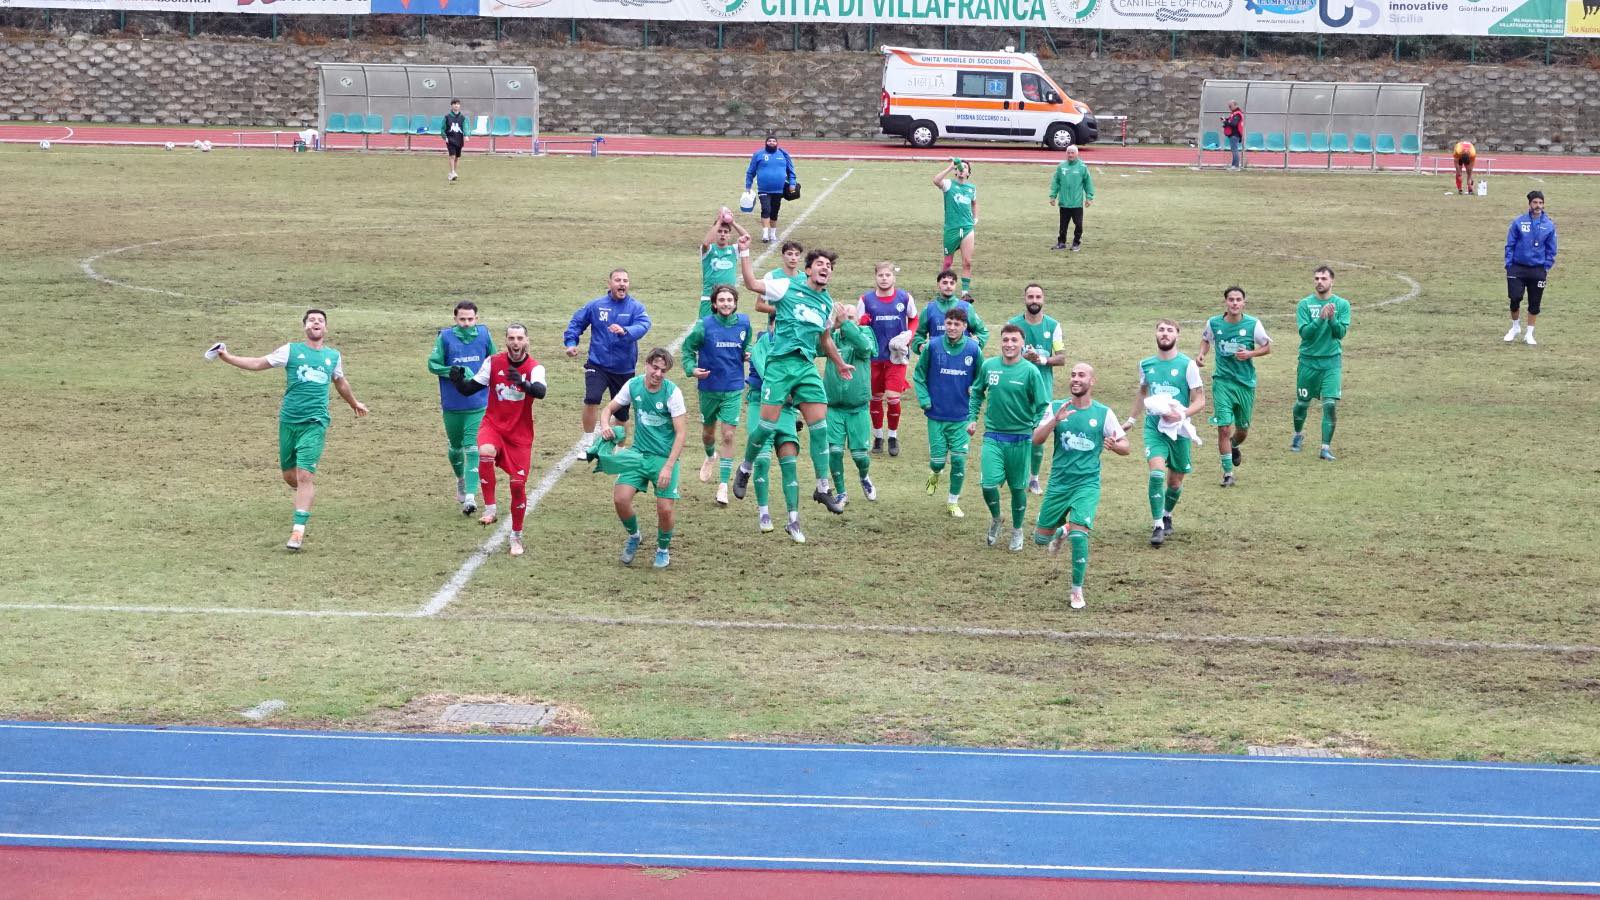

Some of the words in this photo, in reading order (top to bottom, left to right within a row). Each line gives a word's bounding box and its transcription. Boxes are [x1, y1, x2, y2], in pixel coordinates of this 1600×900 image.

[1178, 0, 1224, 10] OFFICINA
[1389, 1, 1449, 11] innovative
[1458, 5, 1490, 13] Giordana
[838, 0, 864, 17] DI
[873, 0, 1047, 21] VILLAFRANCA
[1389, 13, 1424, 24] Sicilia
[598, 310, 609, 322] SA
[1310, 308, 1320, 318] 22
[988, 374, 999, 386] 69
[764, 388, 771, 400] 2
[1298, 388, 1308, 398] 10
